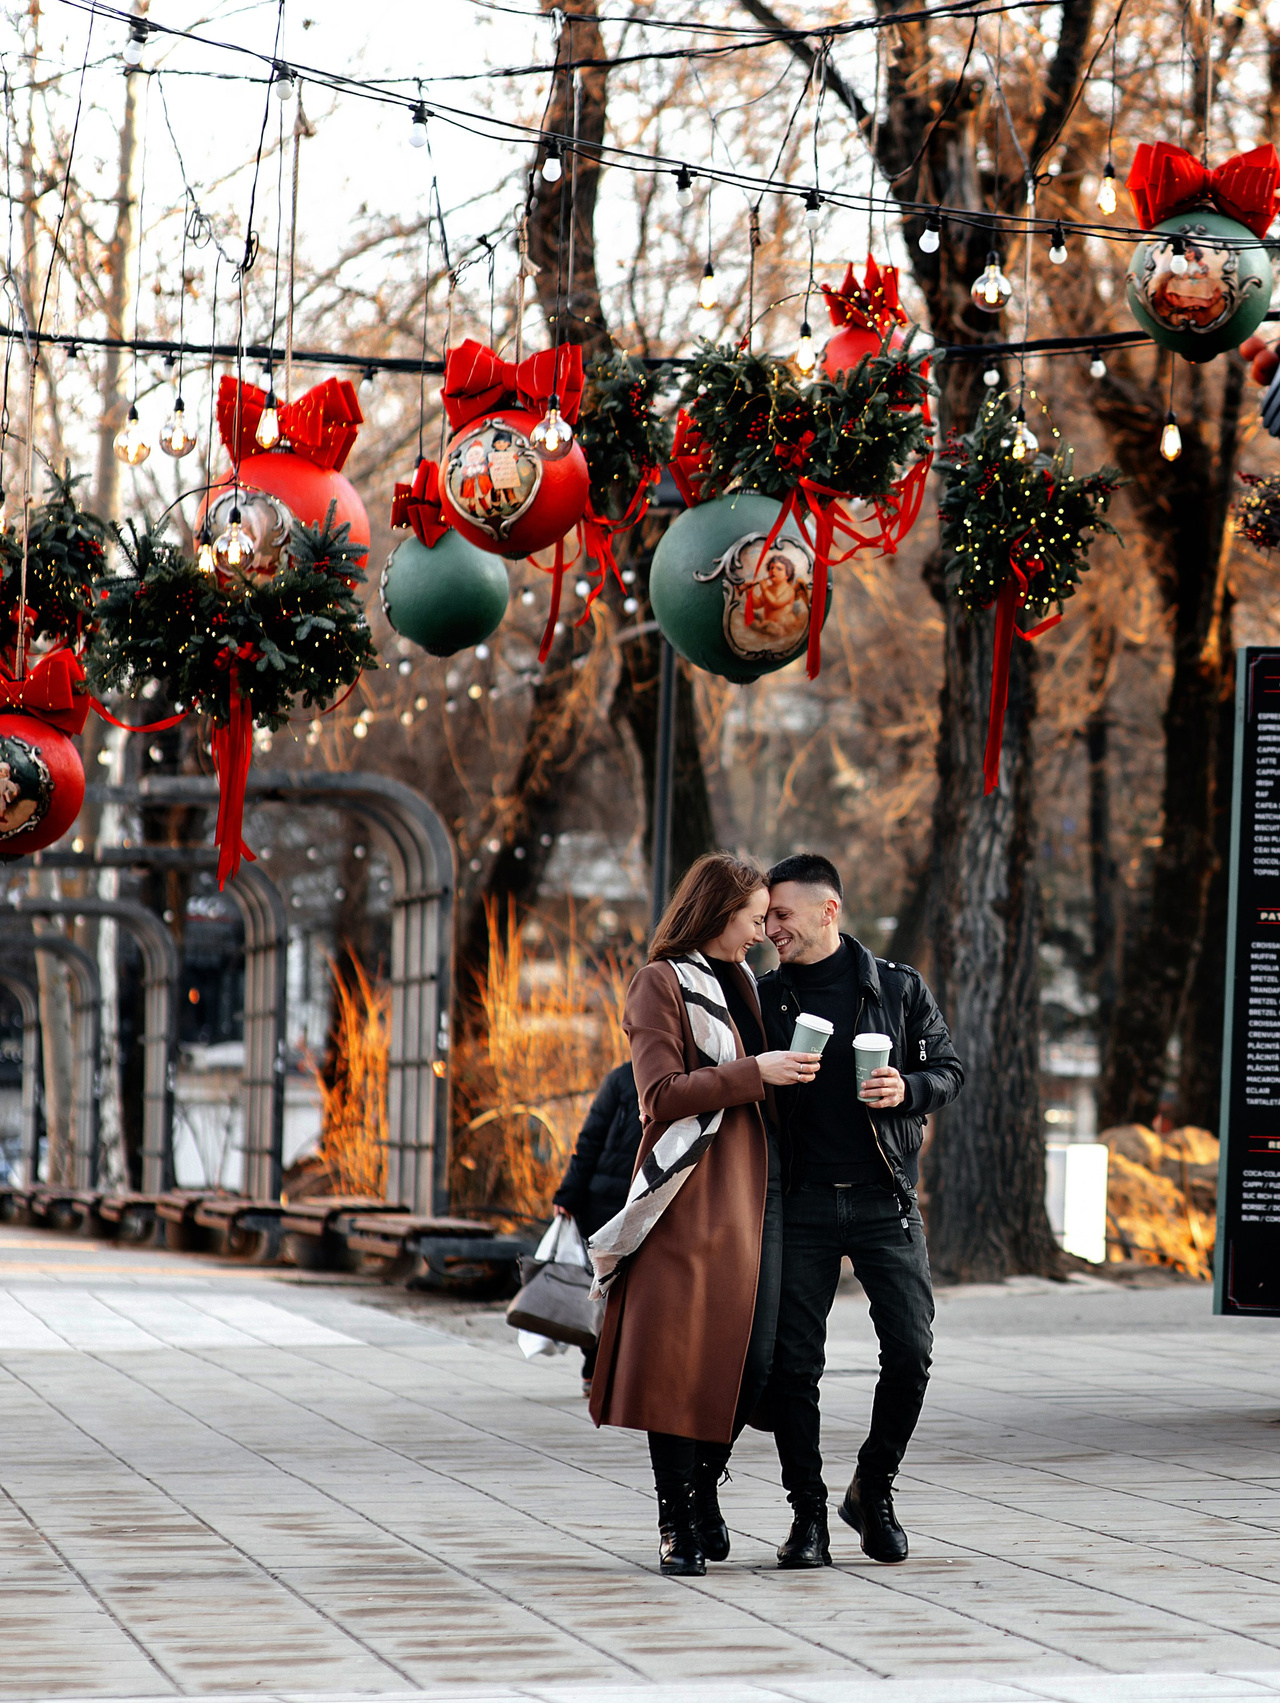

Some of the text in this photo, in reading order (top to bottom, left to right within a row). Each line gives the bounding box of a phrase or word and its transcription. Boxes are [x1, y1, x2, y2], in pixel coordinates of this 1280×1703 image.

[1257, 757, 1277, 765] LATTE
[1255, 802, 1278, 810] CAFEA
[1254, 824, 1280, 832] BISCUIT
[1253, 869, 1279, 877] TOPING
[1242, 1181, 1263, 1189] CAPPY
[1242, 1192, 1255, 1200] SUC
